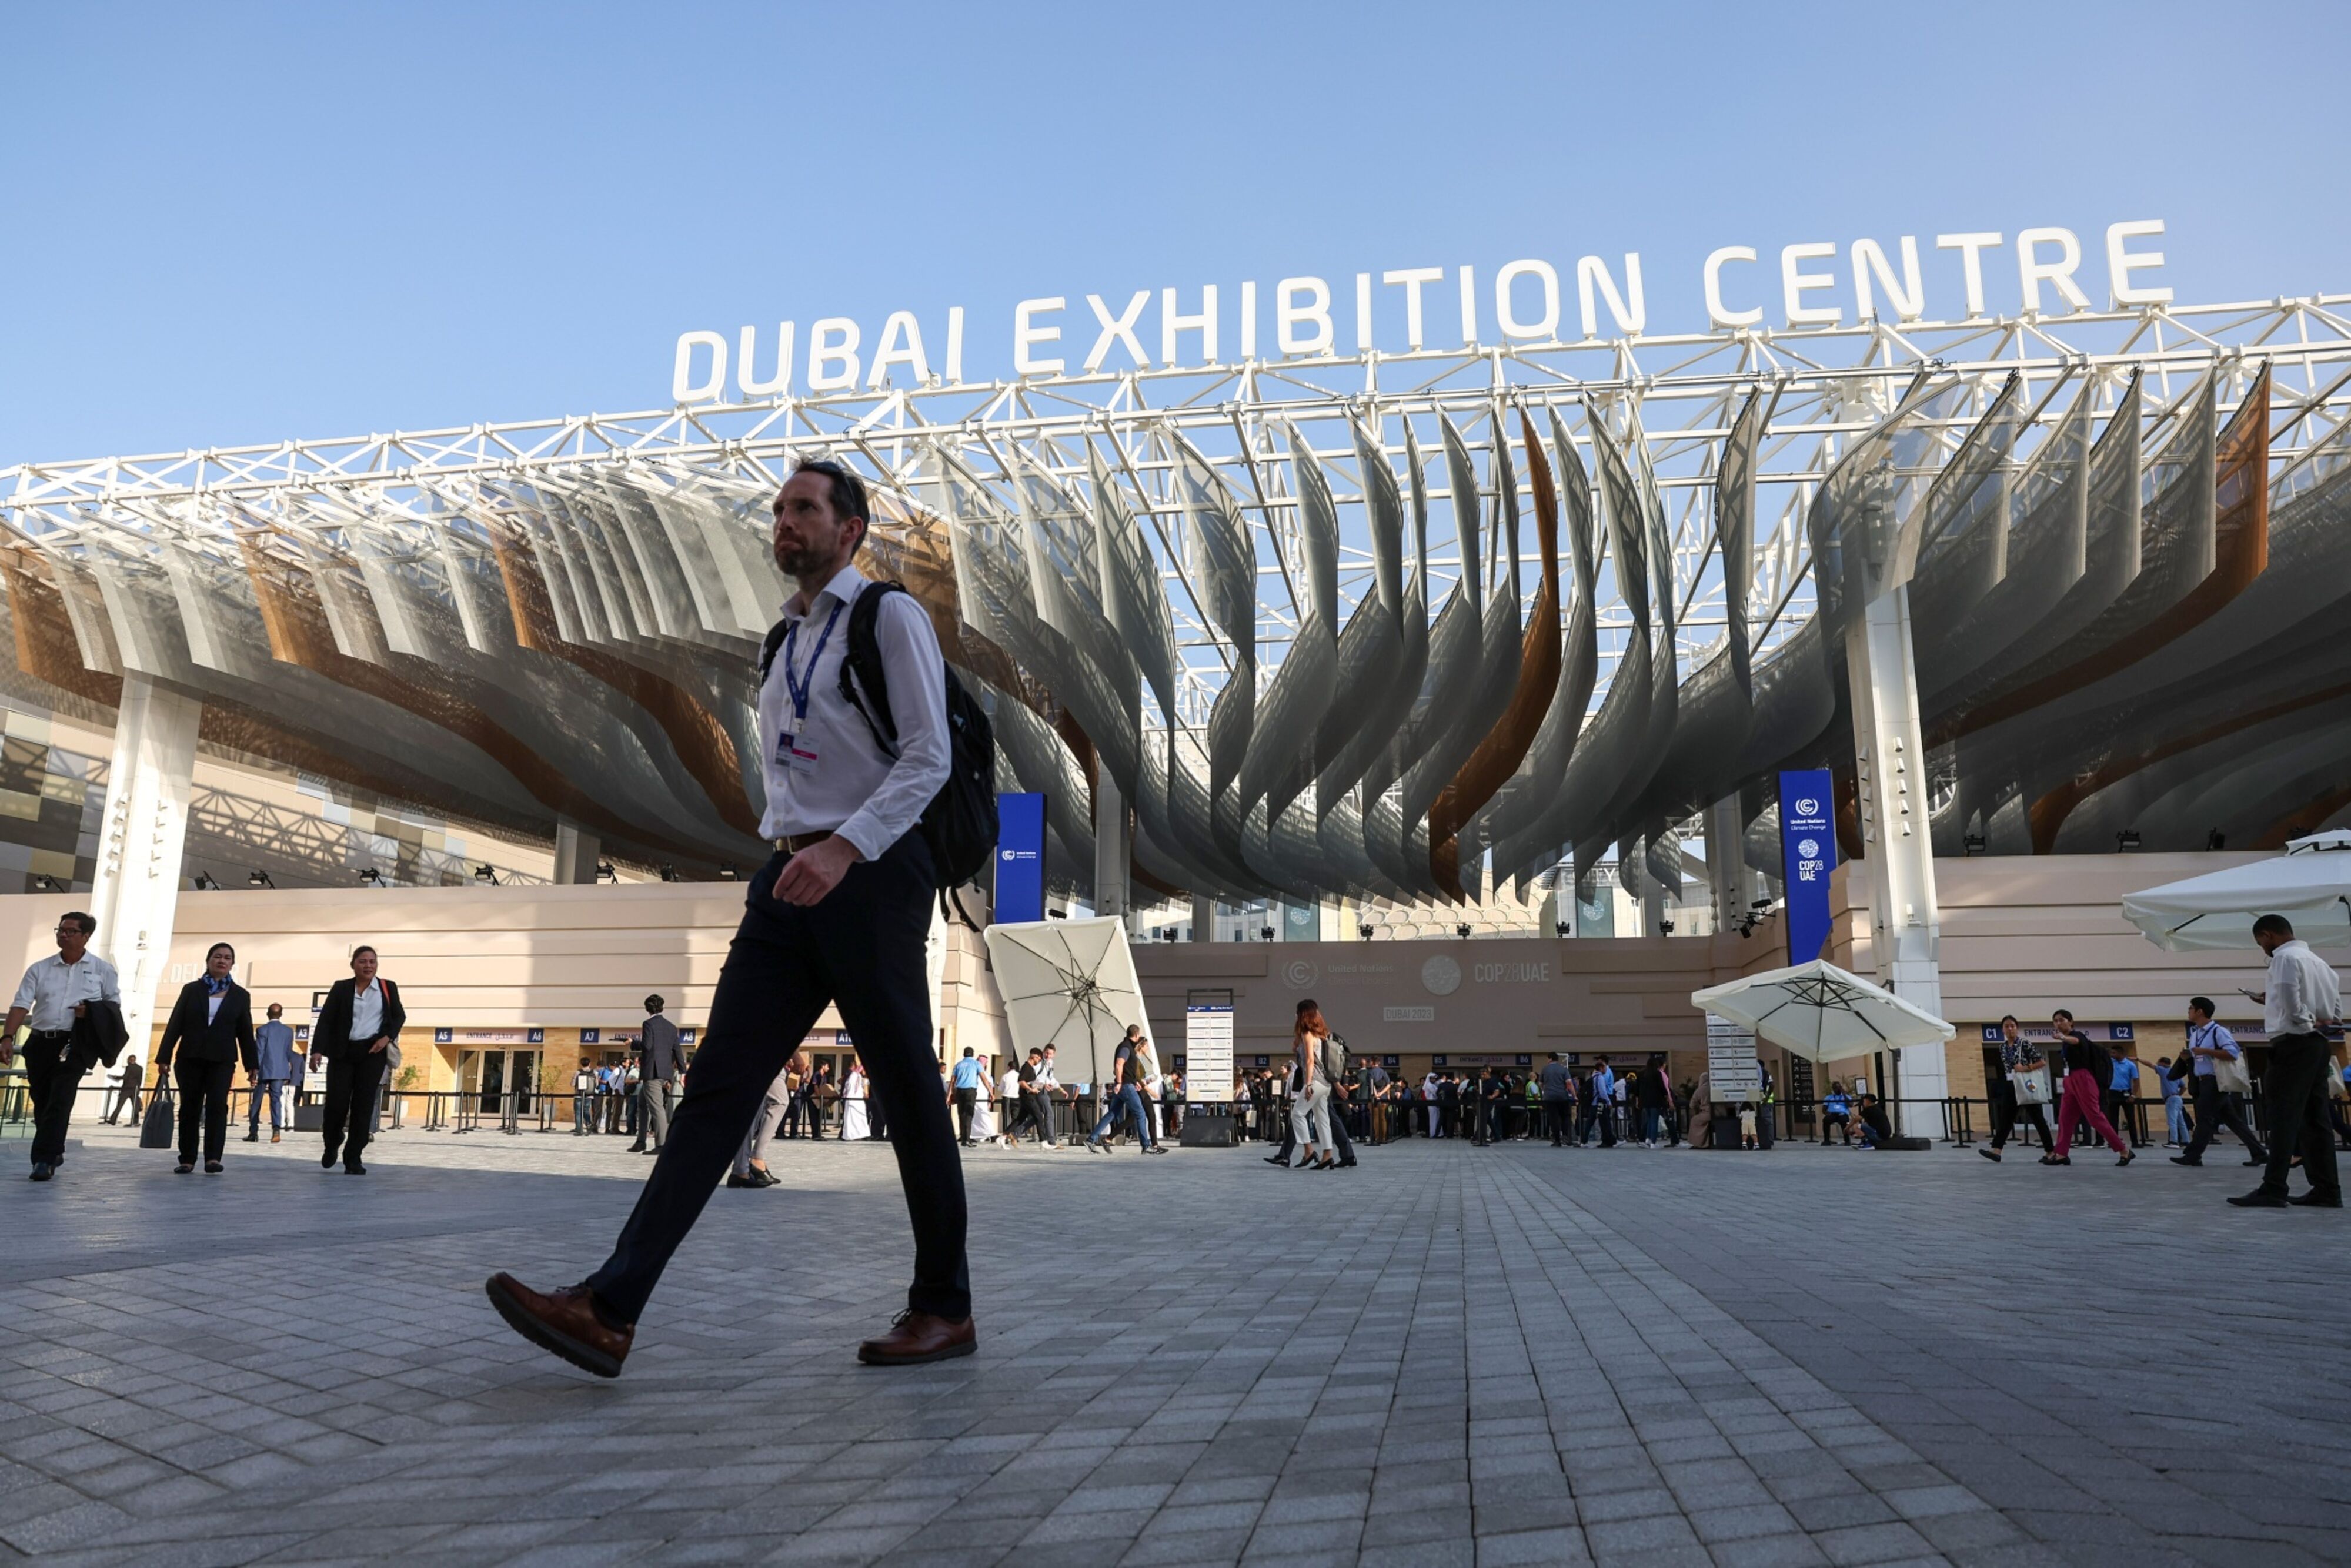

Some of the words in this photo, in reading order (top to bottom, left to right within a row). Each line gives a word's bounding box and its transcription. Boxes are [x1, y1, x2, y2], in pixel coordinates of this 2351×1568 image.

[672, 306, 964, 403] DUBAI
[1014, 252, 1646, 376] EXHIBITION
[1703, 218, 2174, 327] CENTRE
[1799, 860, 1823, 870] COP28
[1799, 870, 1816, 881] UAE
[1328, 964, 1358, 973] United
[1359, 964, 1394, 973] Nations
[1386, 1008, 1410, 1019] DUBAI
[1411, 1008, 1431, 1019] 2023
[298, 1029, 308, 1038] A3
[1986, 1028, 1997, 1038] C1
[2116, 1027, 2129, 1037] C2
[2230, 1025, 2265, 1034] ENTRANC
[438, 1031, 448, 1041] A5
[532, 1031, 542, 1041] A6
[585, 1031, 594, 1041] A7
[683, 1032, 693, 1041] A8
